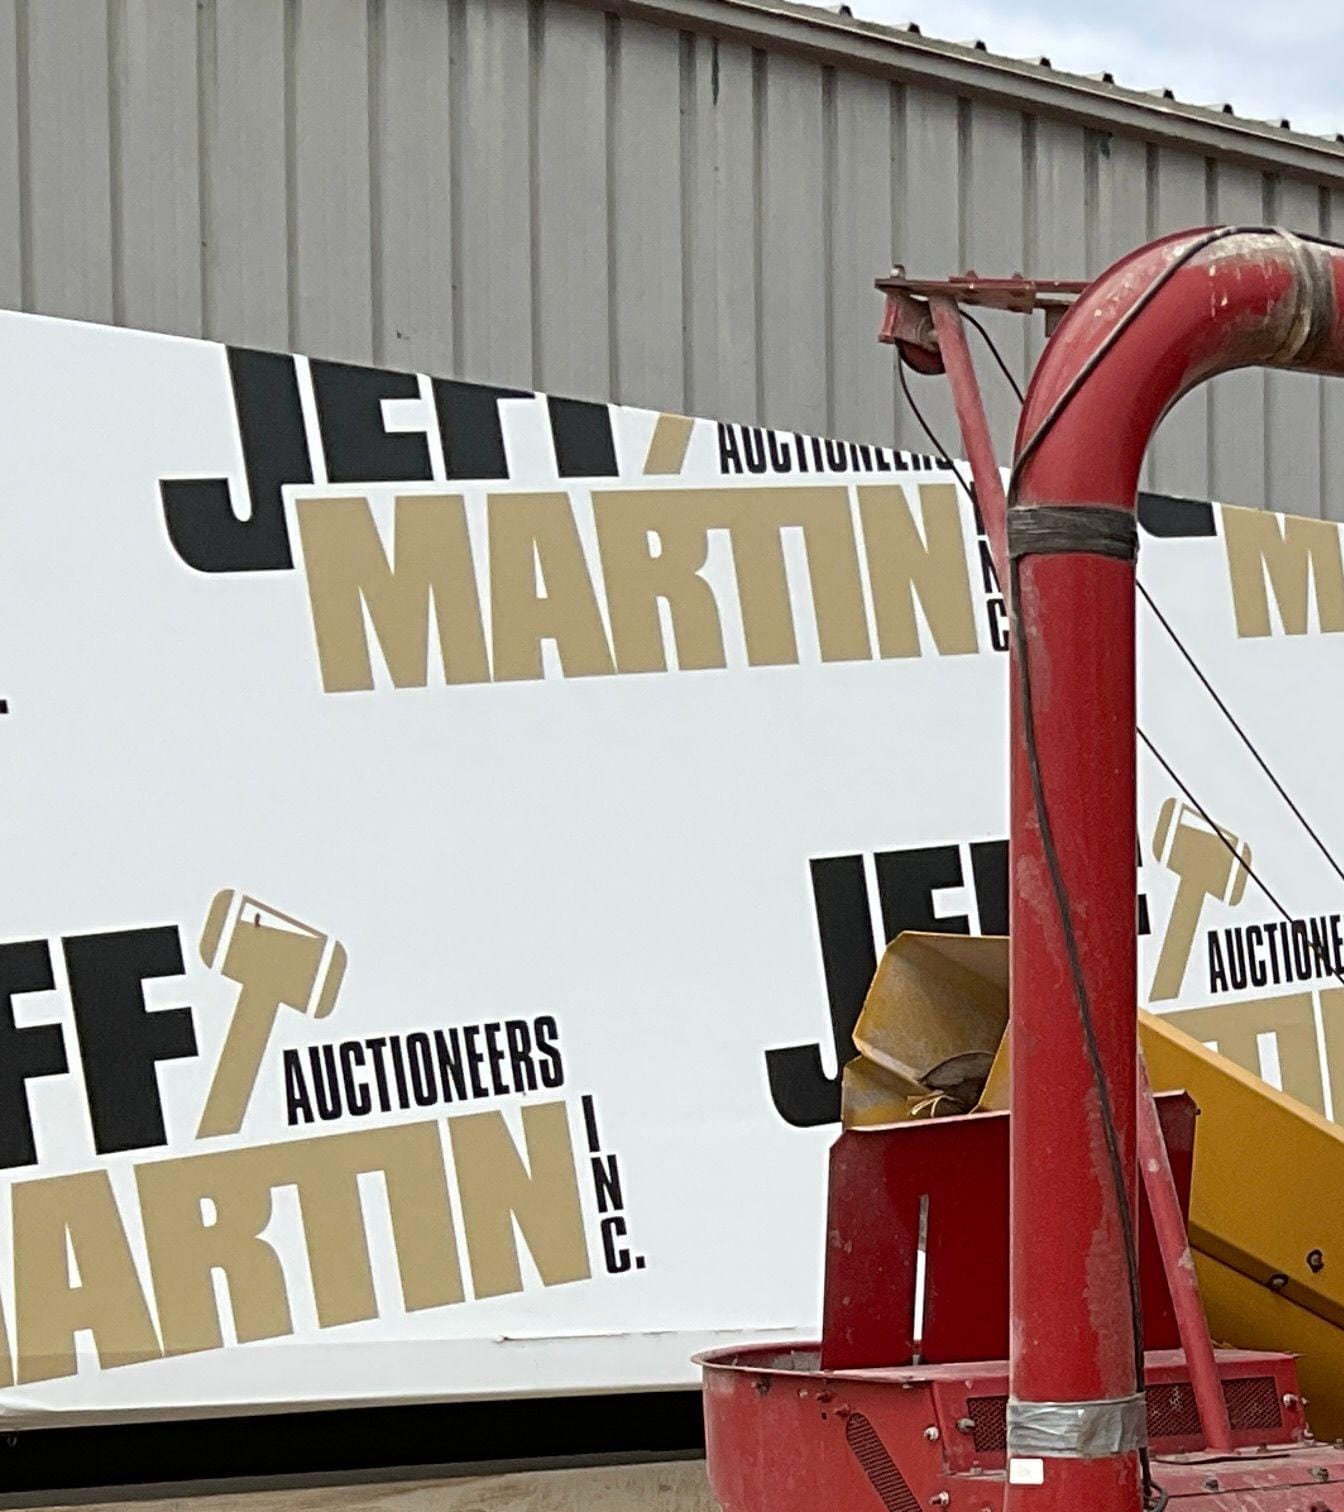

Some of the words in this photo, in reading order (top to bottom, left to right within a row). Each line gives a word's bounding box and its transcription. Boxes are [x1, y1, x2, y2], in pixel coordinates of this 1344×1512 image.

[295, 483, 979, 694] MARTIN
[283, 1015, 565, 1126] AUCTIONEERS
[764, 838, 1151, 1128] JE
[0, 1100, 593, 1389] ARTIN
